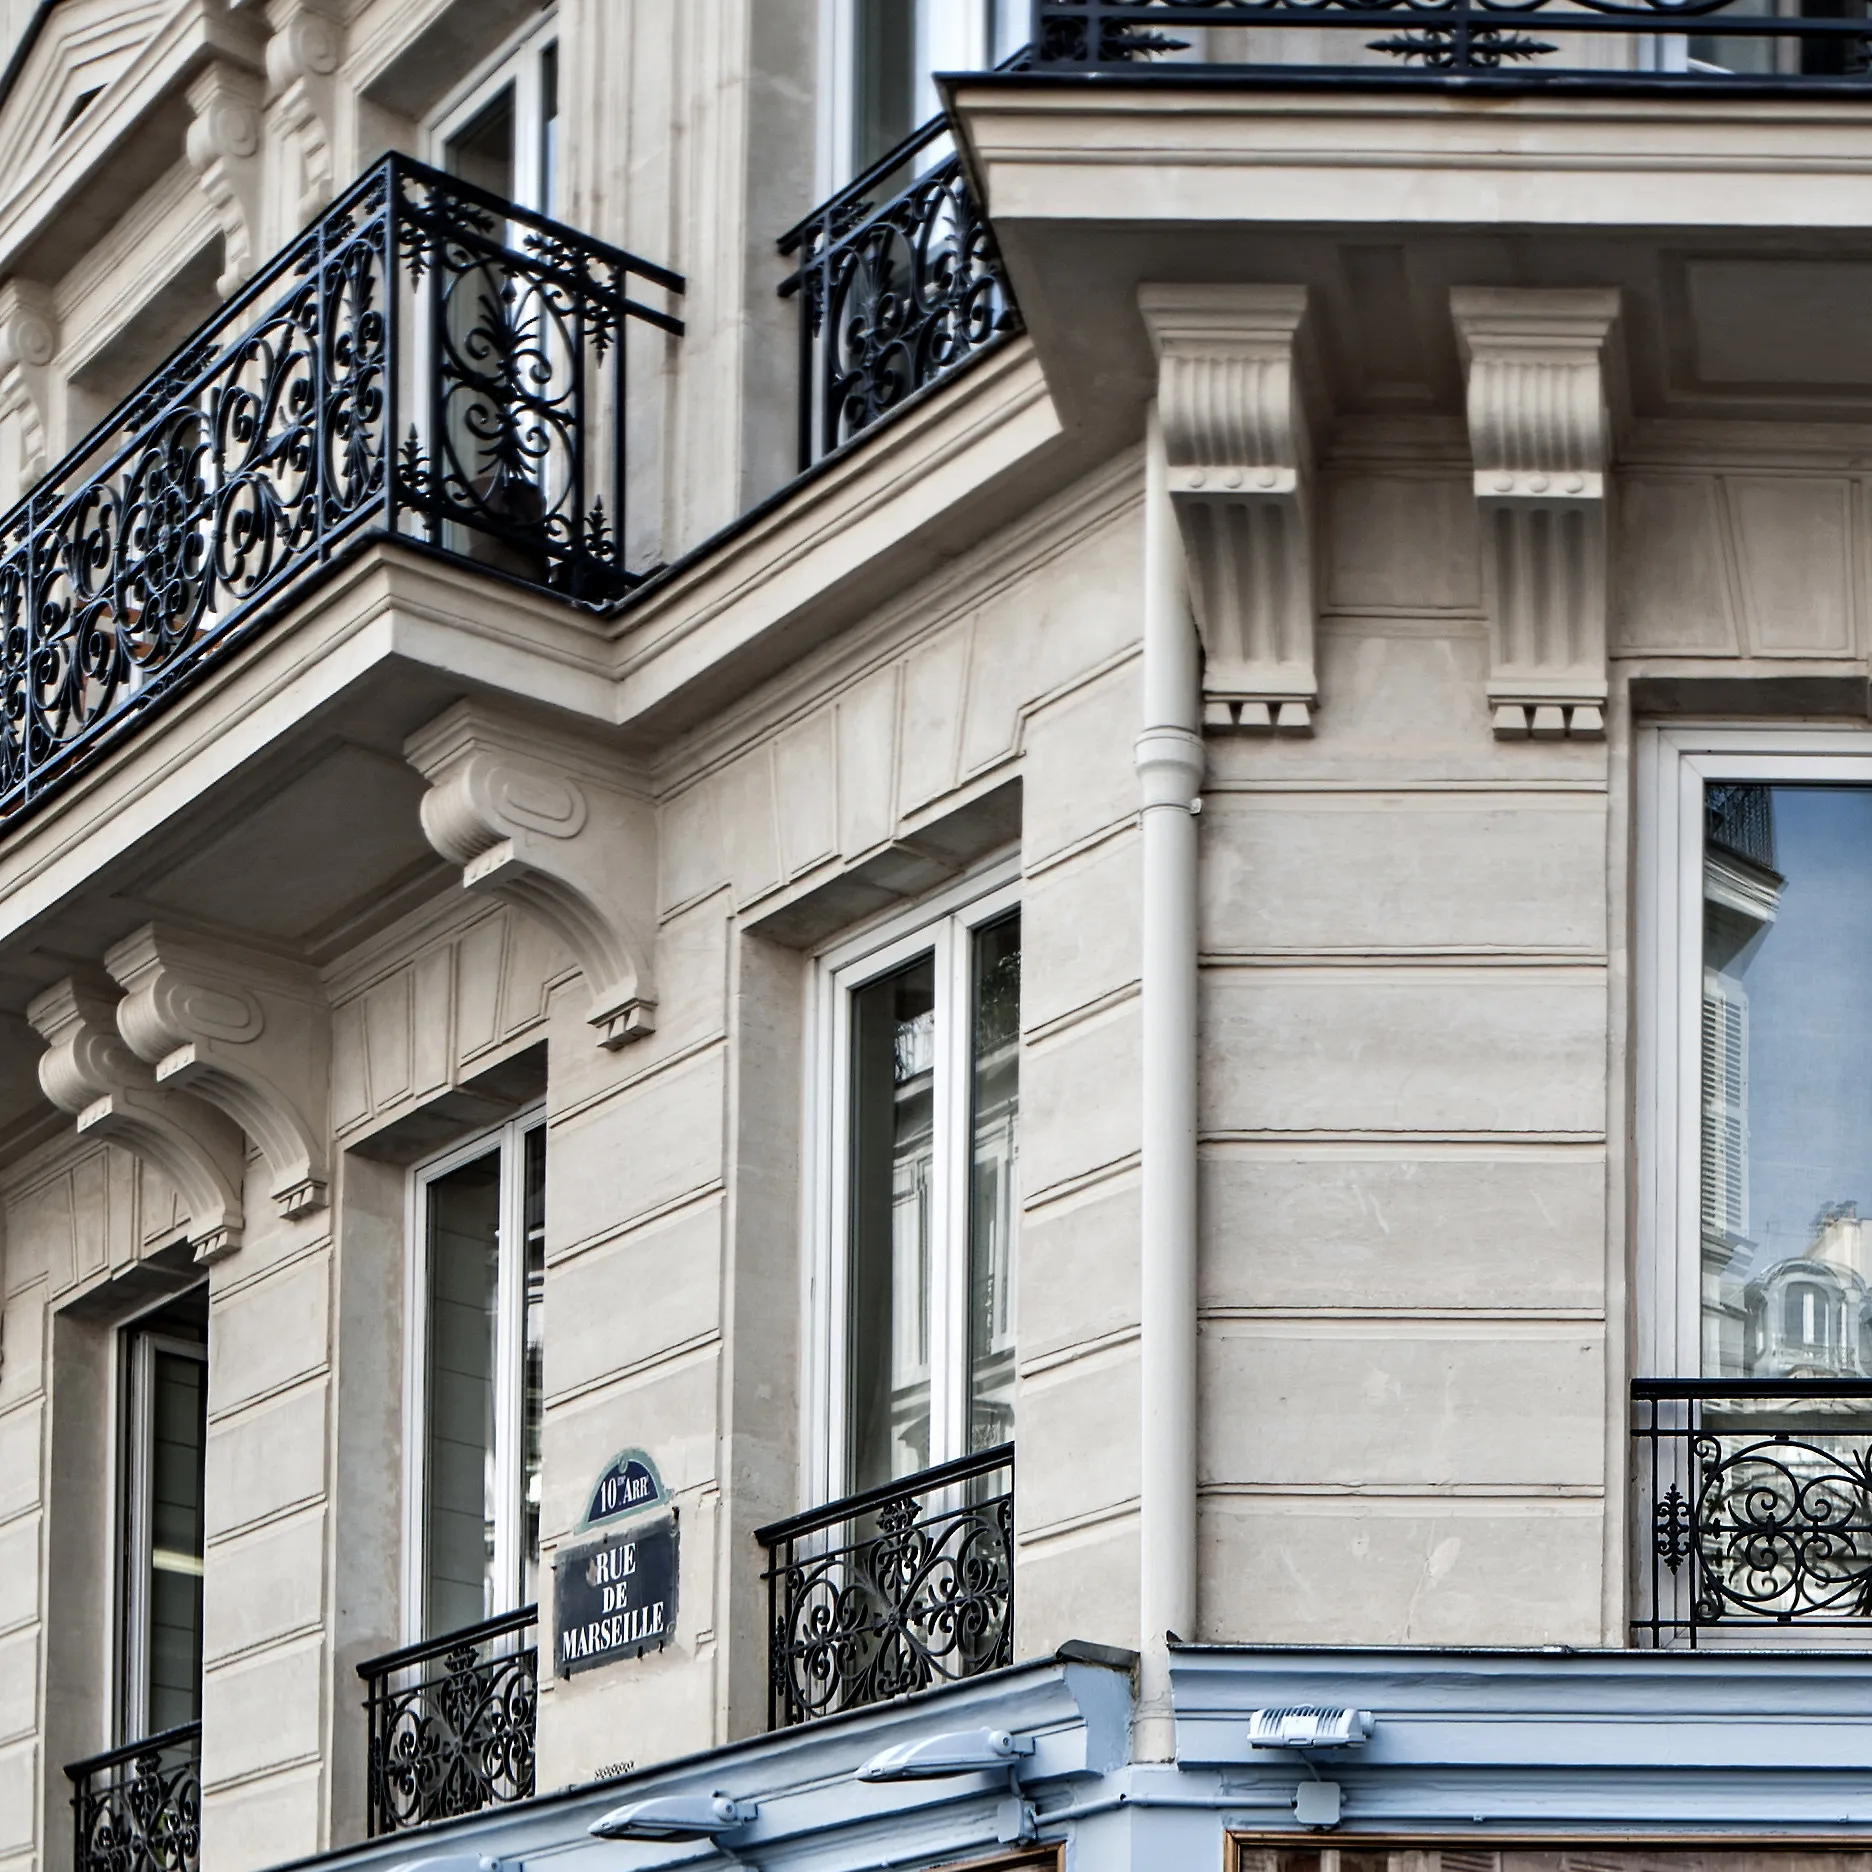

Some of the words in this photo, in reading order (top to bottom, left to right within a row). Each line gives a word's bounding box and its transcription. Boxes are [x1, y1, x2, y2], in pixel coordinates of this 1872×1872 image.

[595, 1542, 636, 1585] RUE
[602, 1581, 628, 1614] DE
[562, 1601, 664, 1662] MARSEILLE
